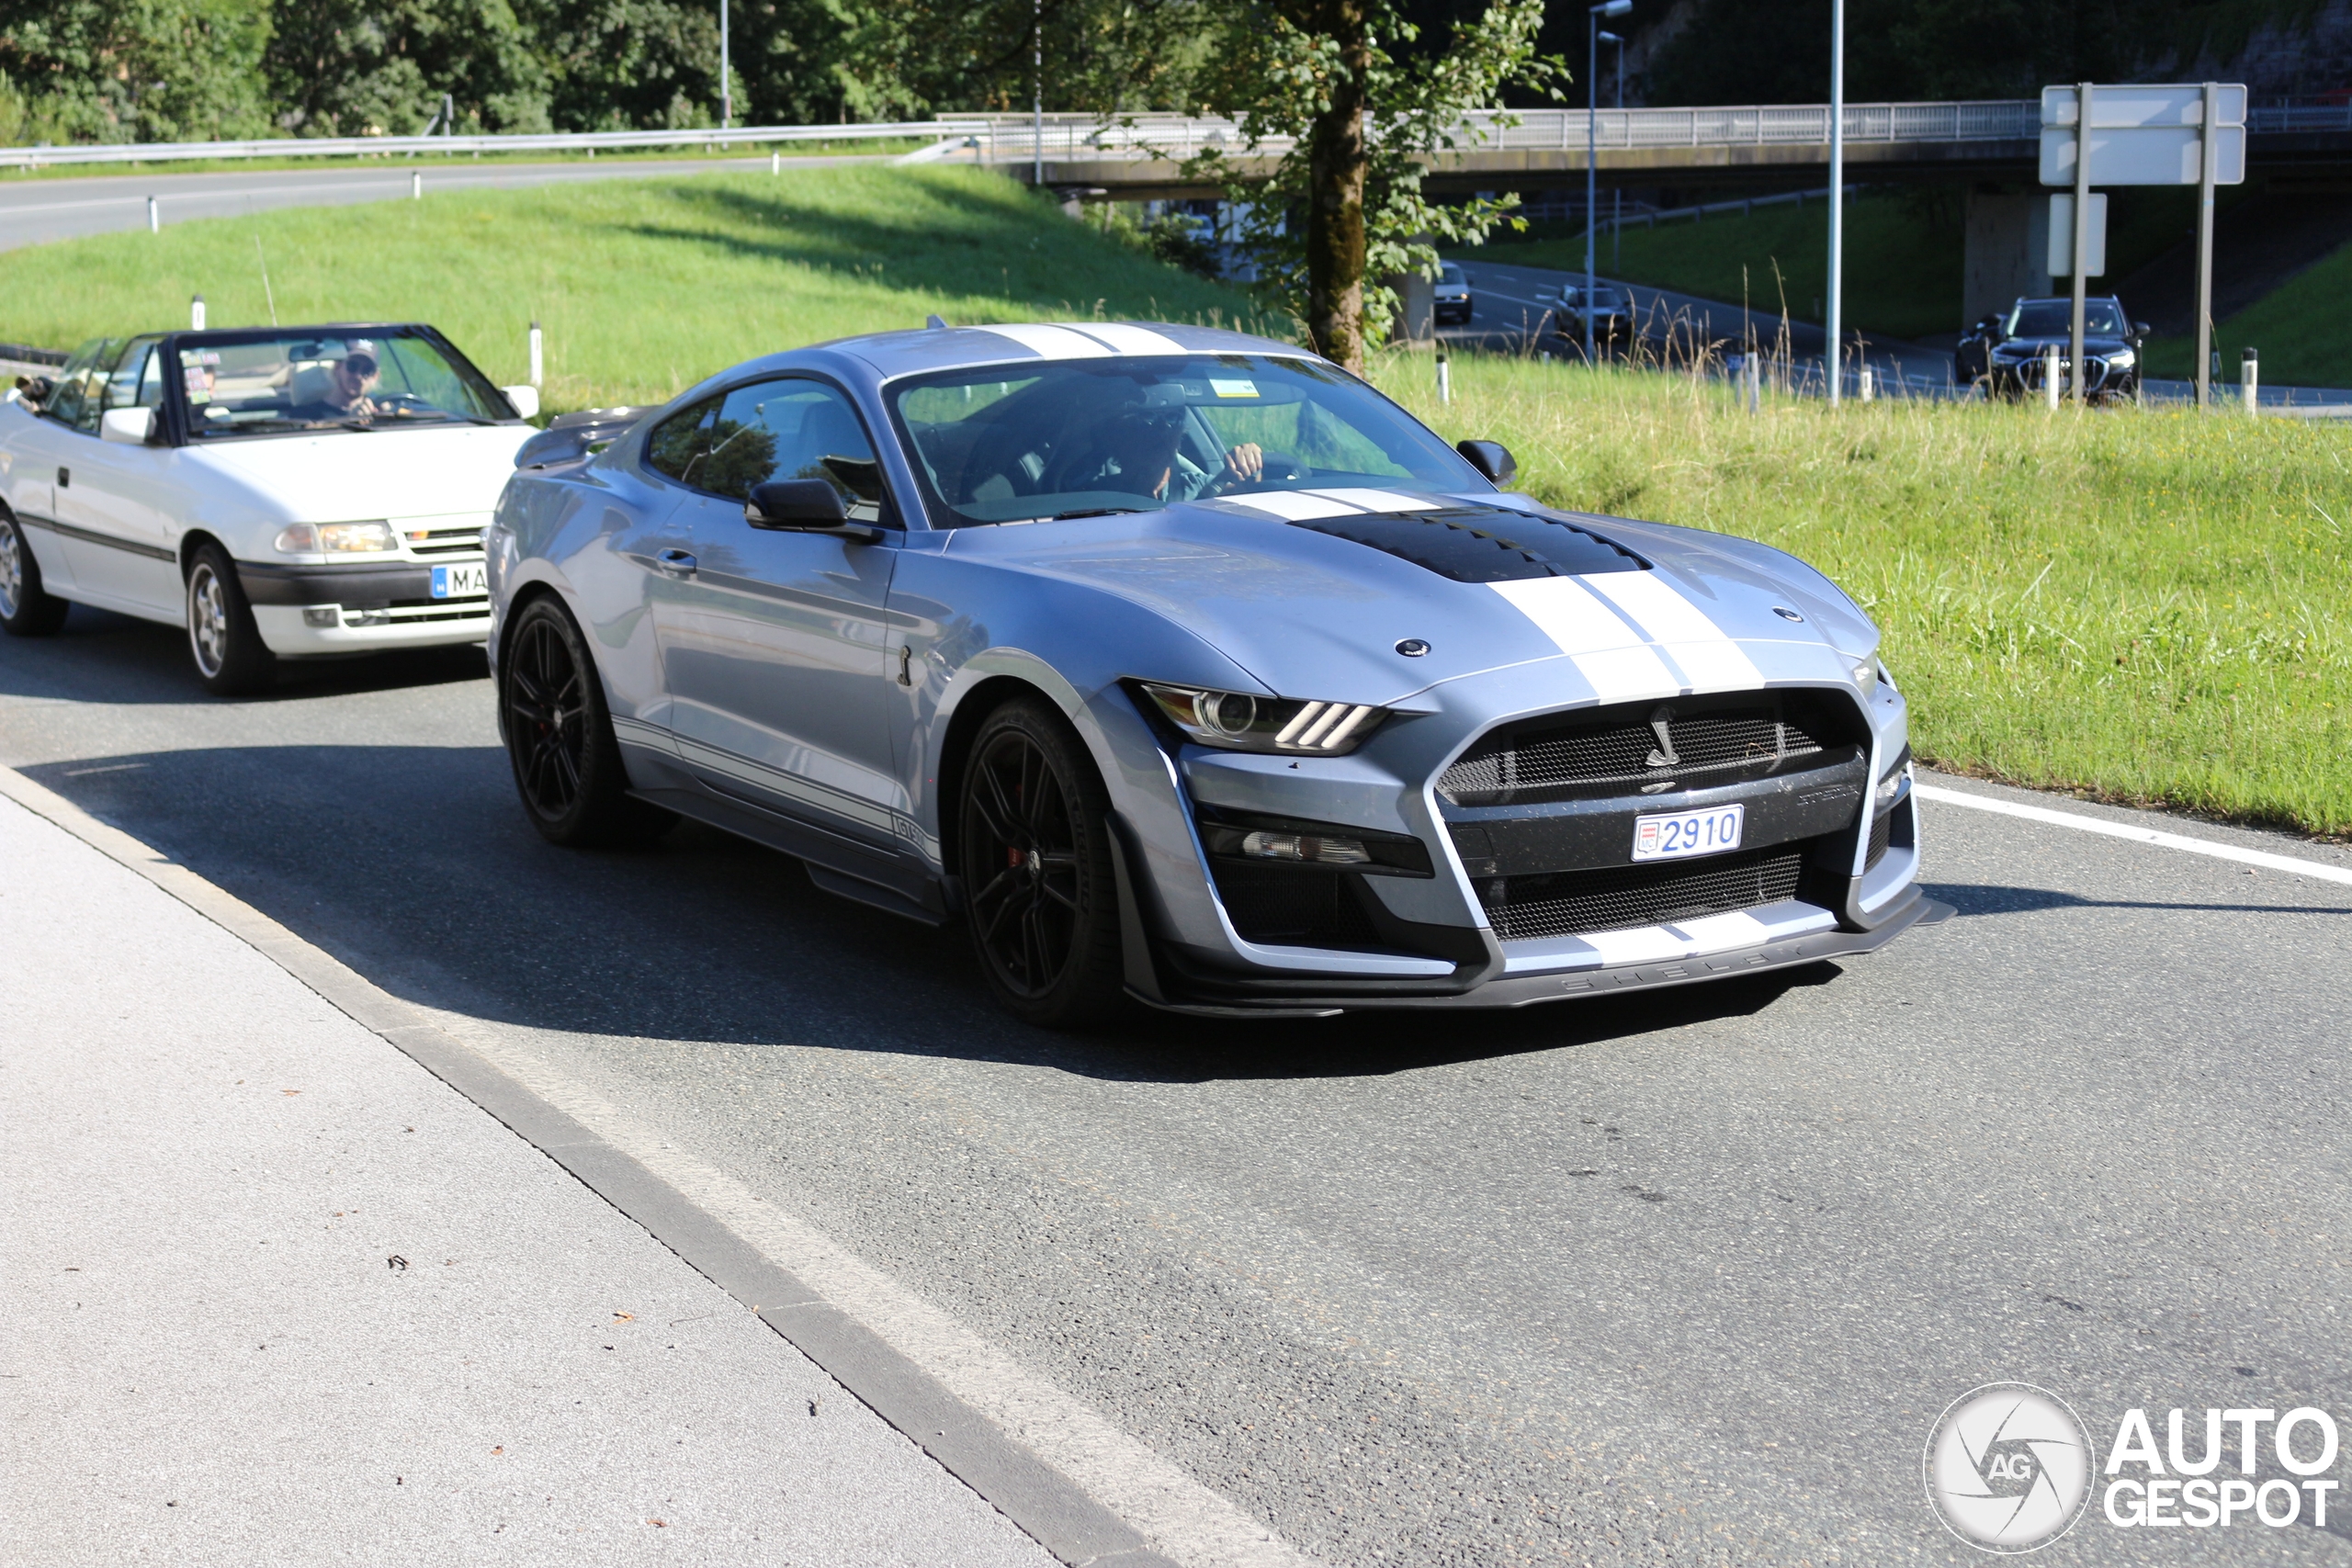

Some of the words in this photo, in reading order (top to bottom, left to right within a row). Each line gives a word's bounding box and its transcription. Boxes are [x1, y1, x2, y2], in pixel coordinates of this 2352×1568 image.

[453, 569, 488, 592] MA
[1661, 813, 1736, 852] 2910
[1561, 944, 1802, 990] SHELBY
